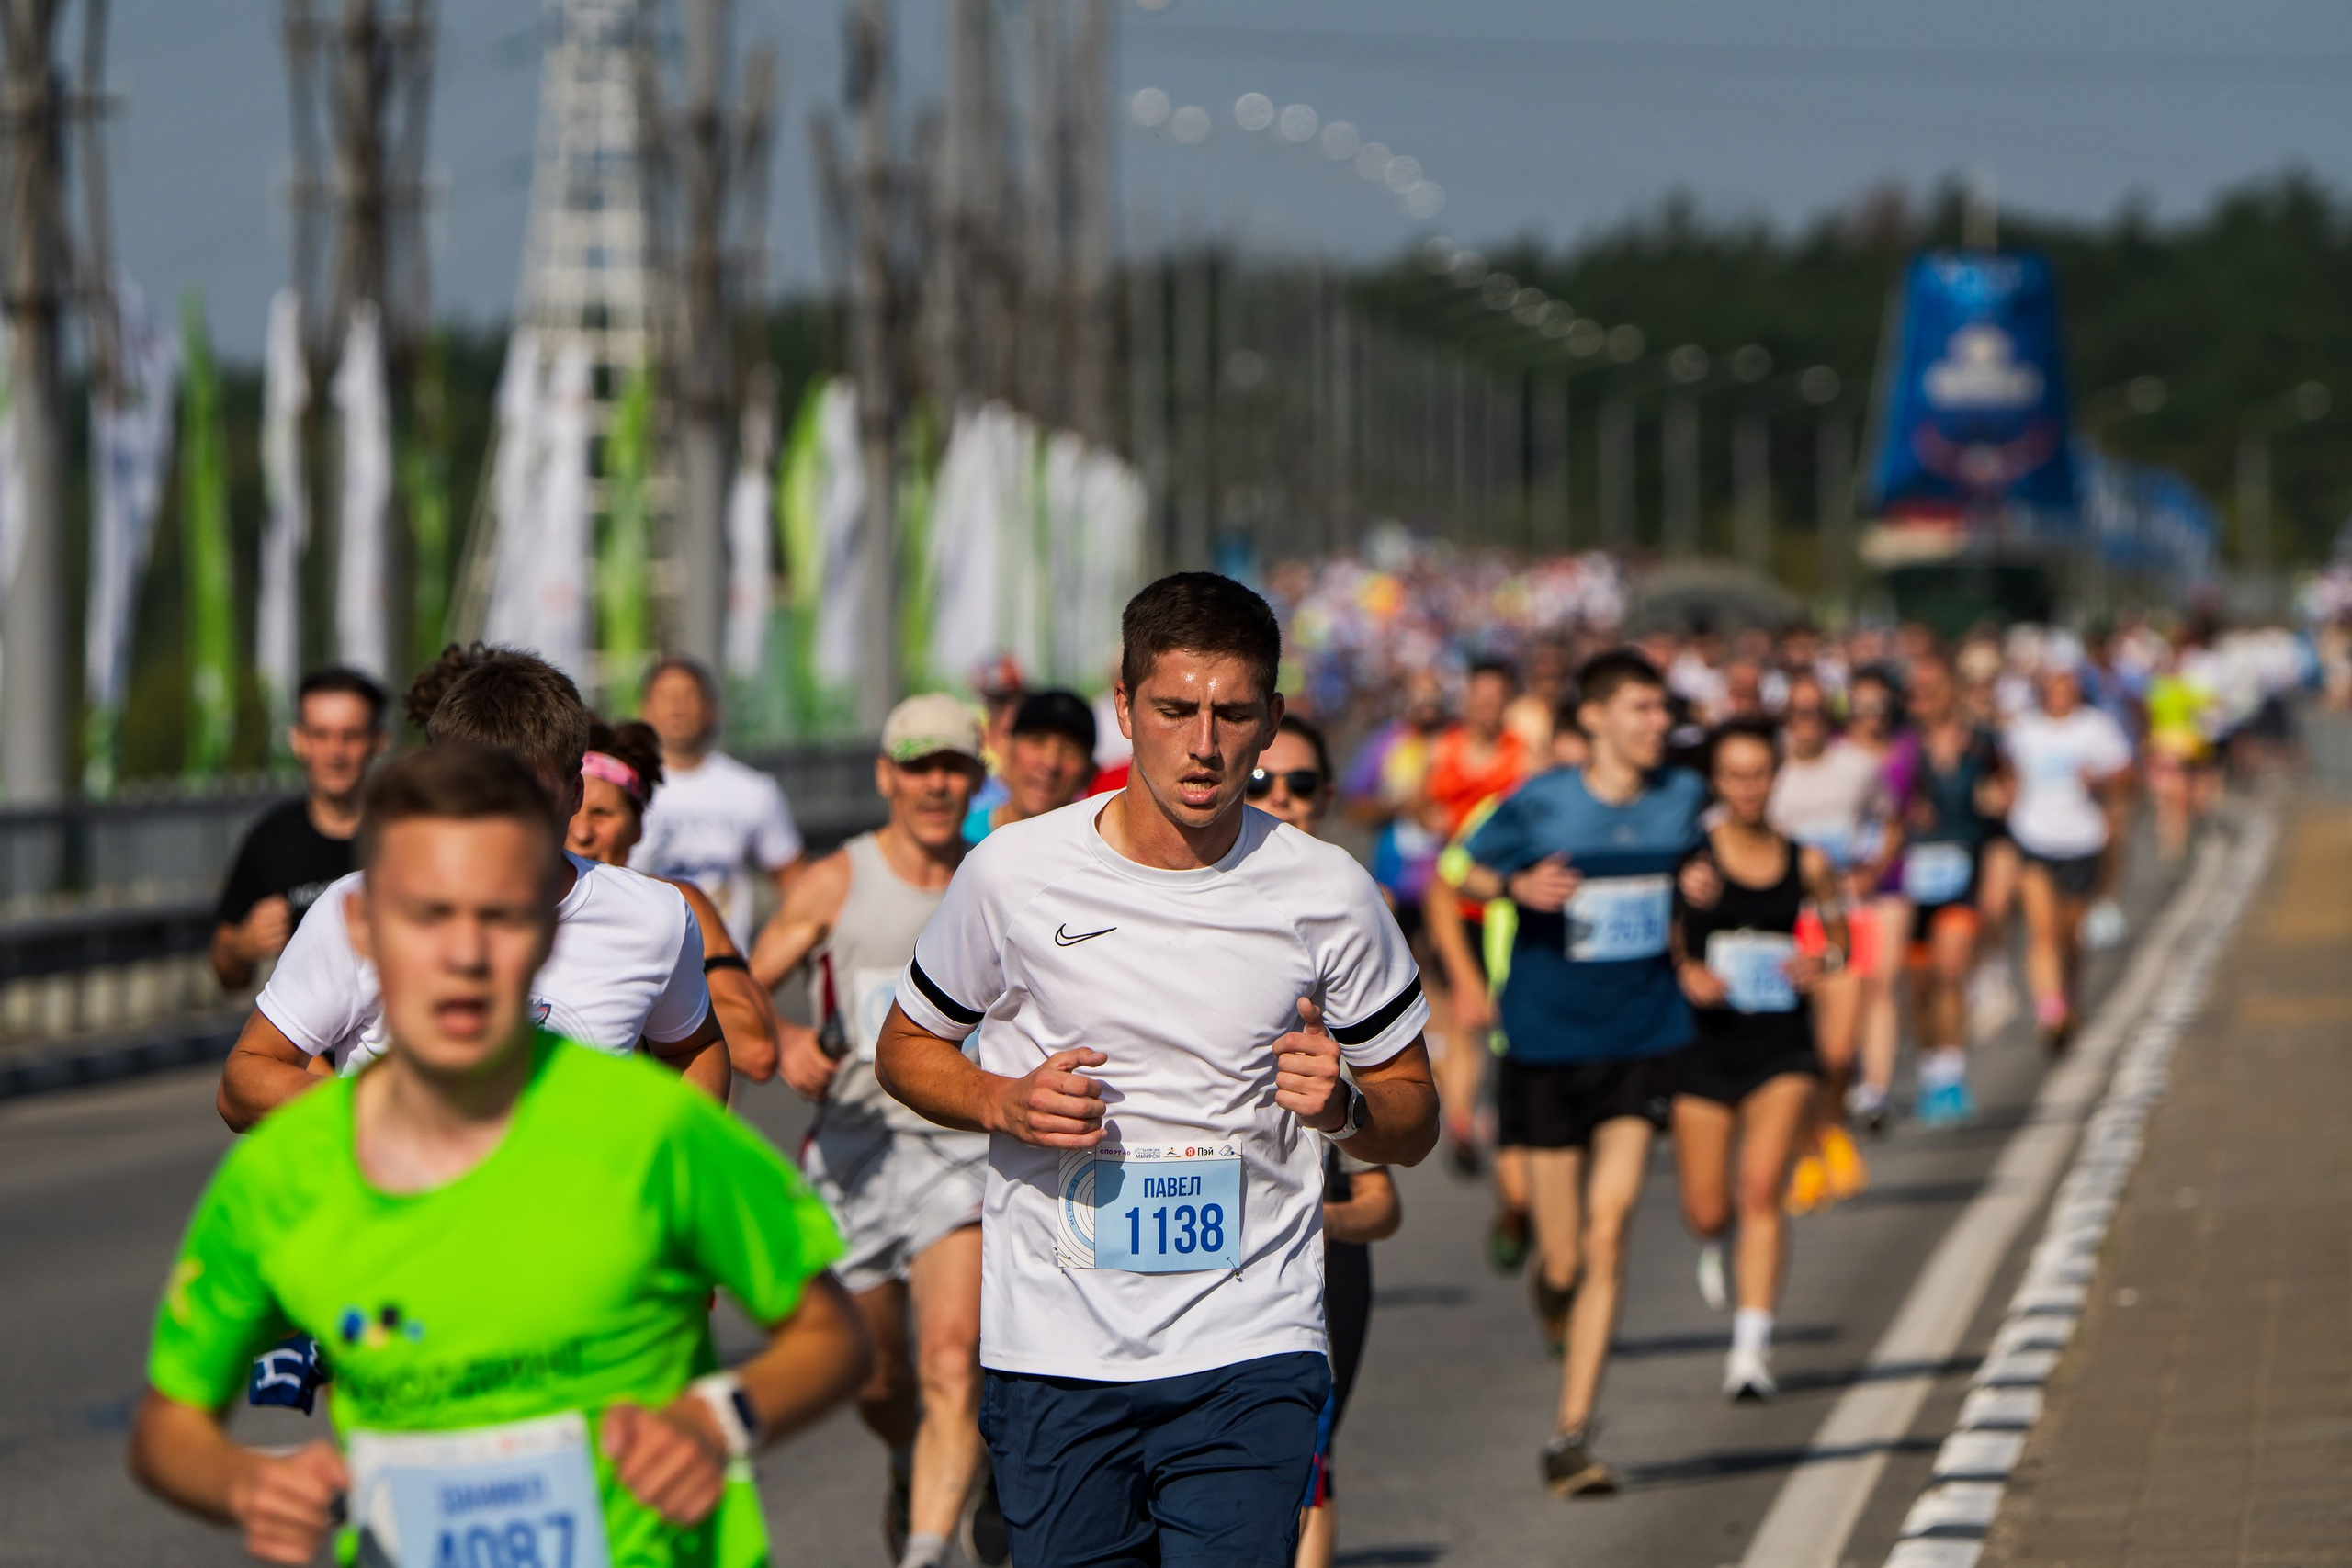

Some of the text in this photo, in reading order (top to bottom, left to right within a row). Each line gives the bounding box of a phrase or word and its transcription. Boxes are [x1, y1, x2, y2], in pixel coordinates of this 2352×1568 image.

[1197, 1147, 1214, 1156] Пэй
[1144, 1176, 1201, 1198] ПАВЕЛ
[1125, 1203, 1224, 1255] 1138
